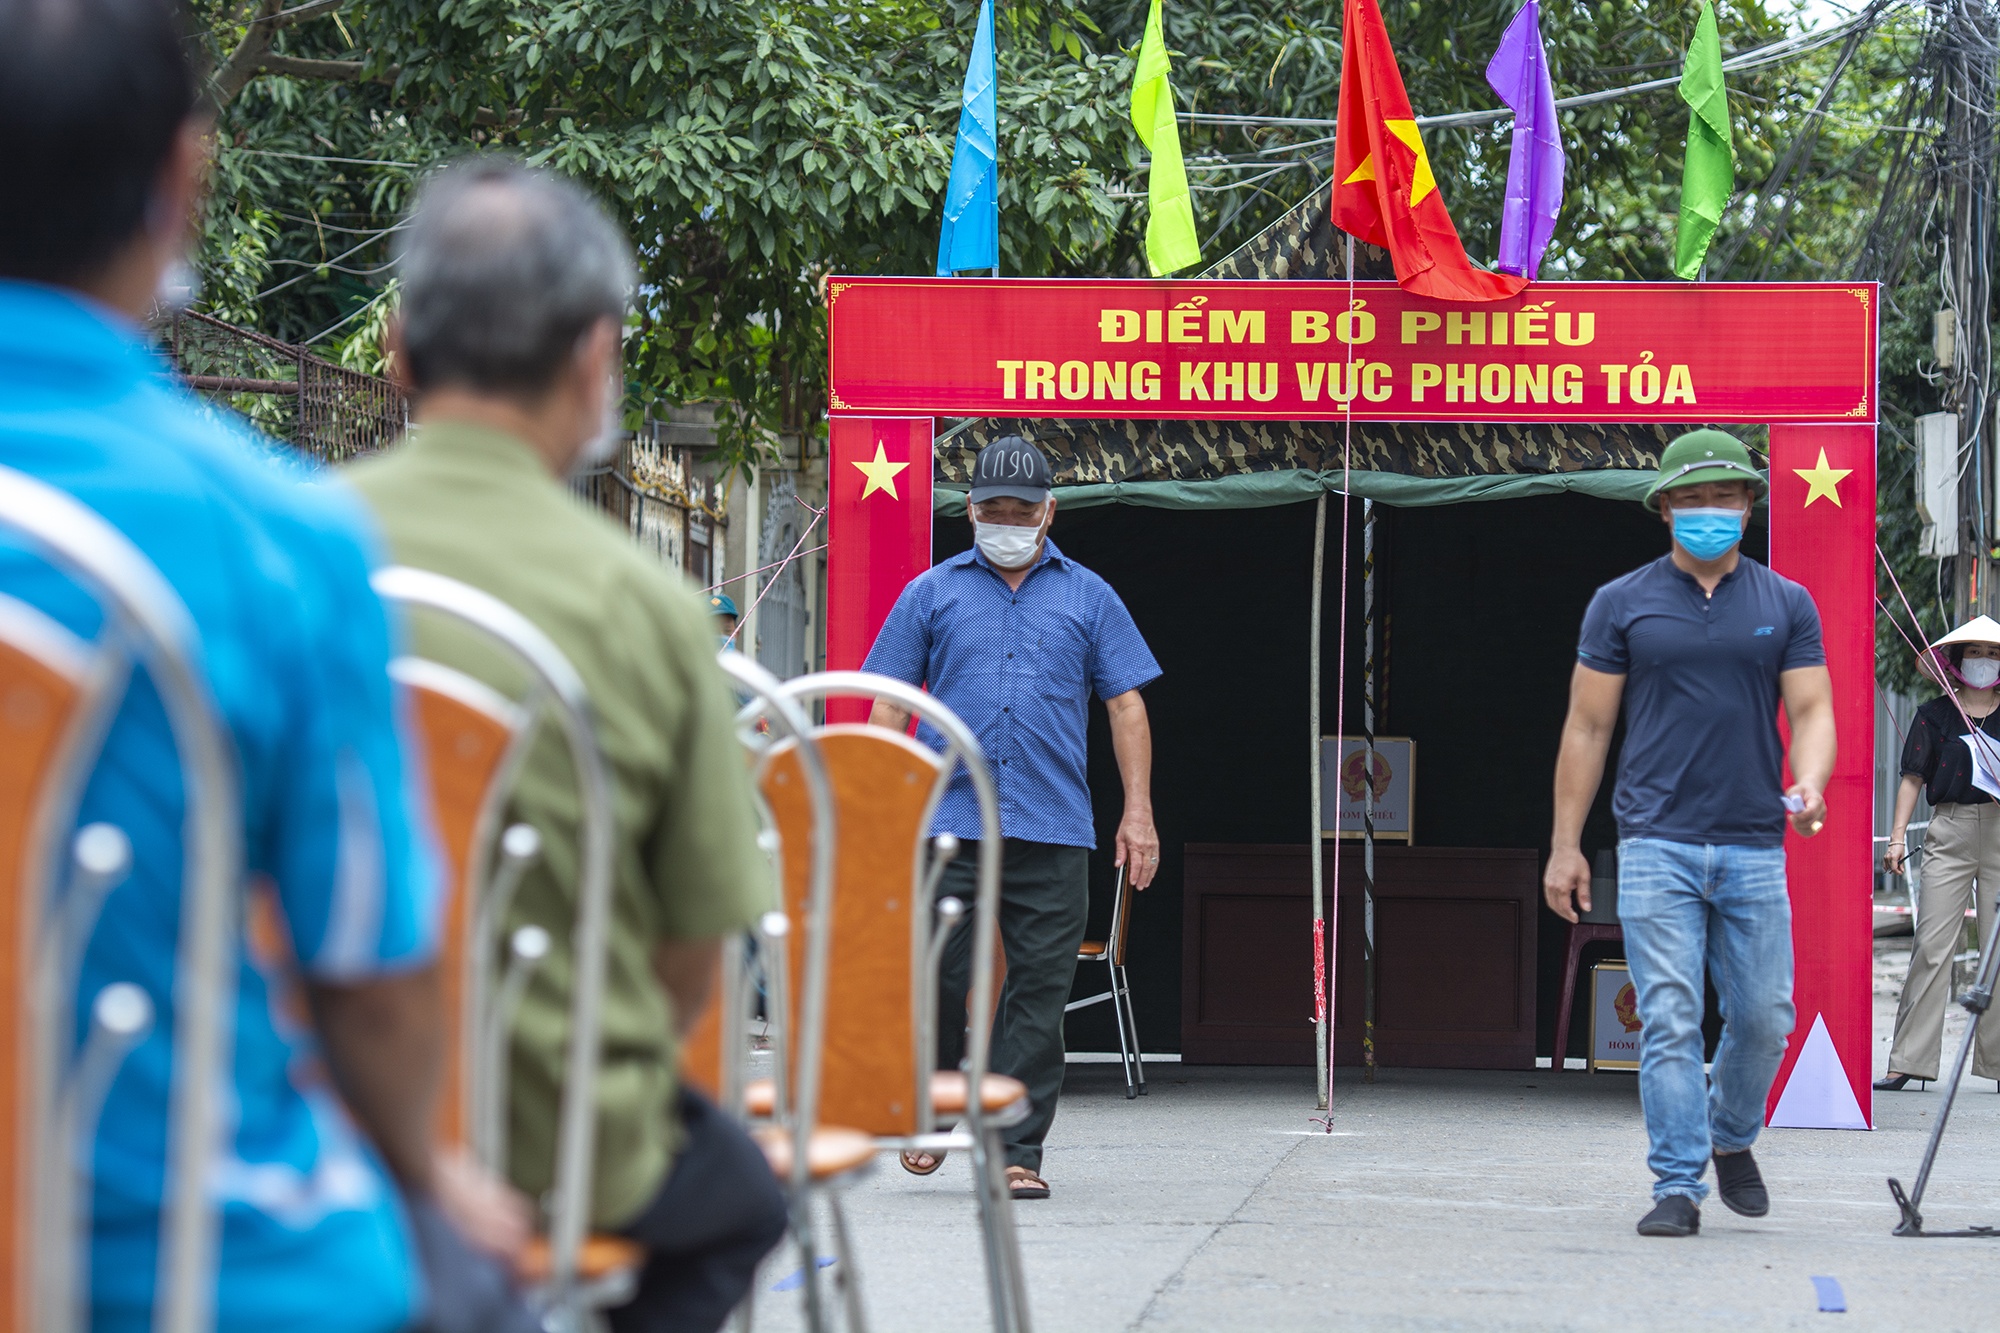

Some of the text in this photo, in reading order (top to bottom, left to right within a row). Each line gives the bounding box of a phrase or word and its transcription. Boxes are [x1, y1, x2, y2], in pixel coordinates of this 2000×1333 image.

[1097, 295, 1596, 347] ĐIỂM BỎ PHIẾU
[996, 350, 1697, 411] TRONG KHU VỰC PHONG TỎA
